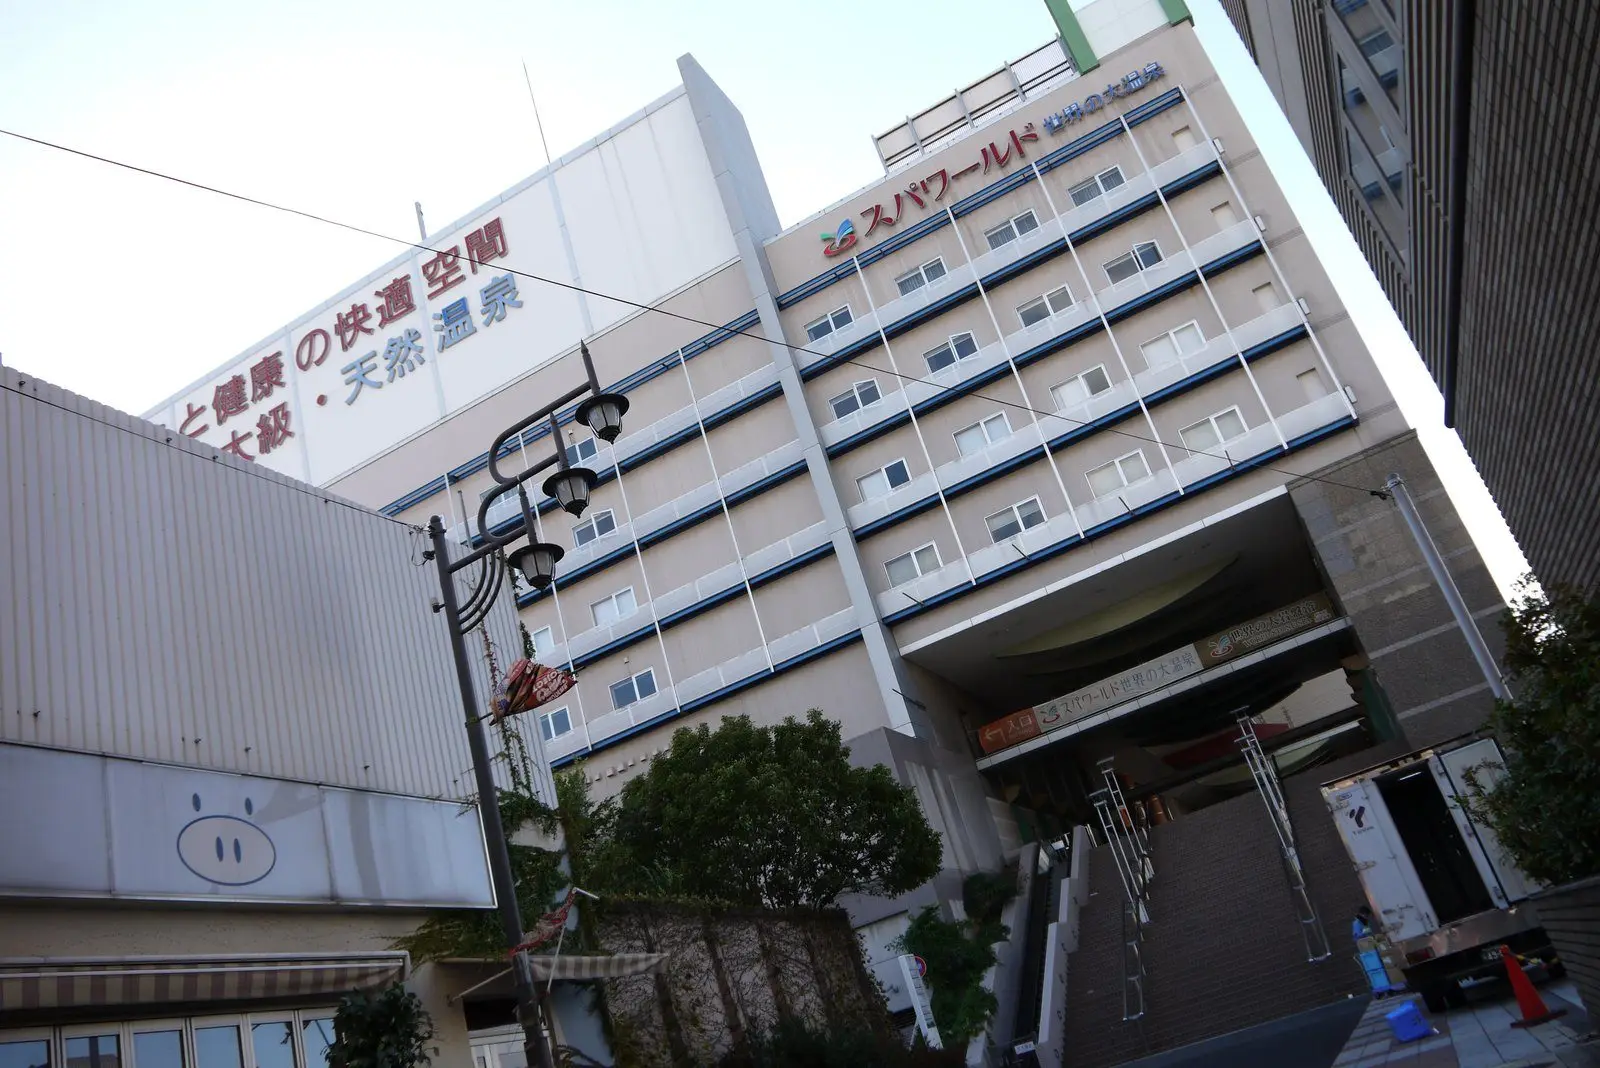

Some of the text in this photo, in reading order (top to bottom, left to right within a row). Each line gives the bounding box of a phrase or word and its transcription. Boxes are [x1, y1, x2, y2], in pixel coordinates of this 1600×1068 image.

[860, 122, 1039, 237] スパワールド
